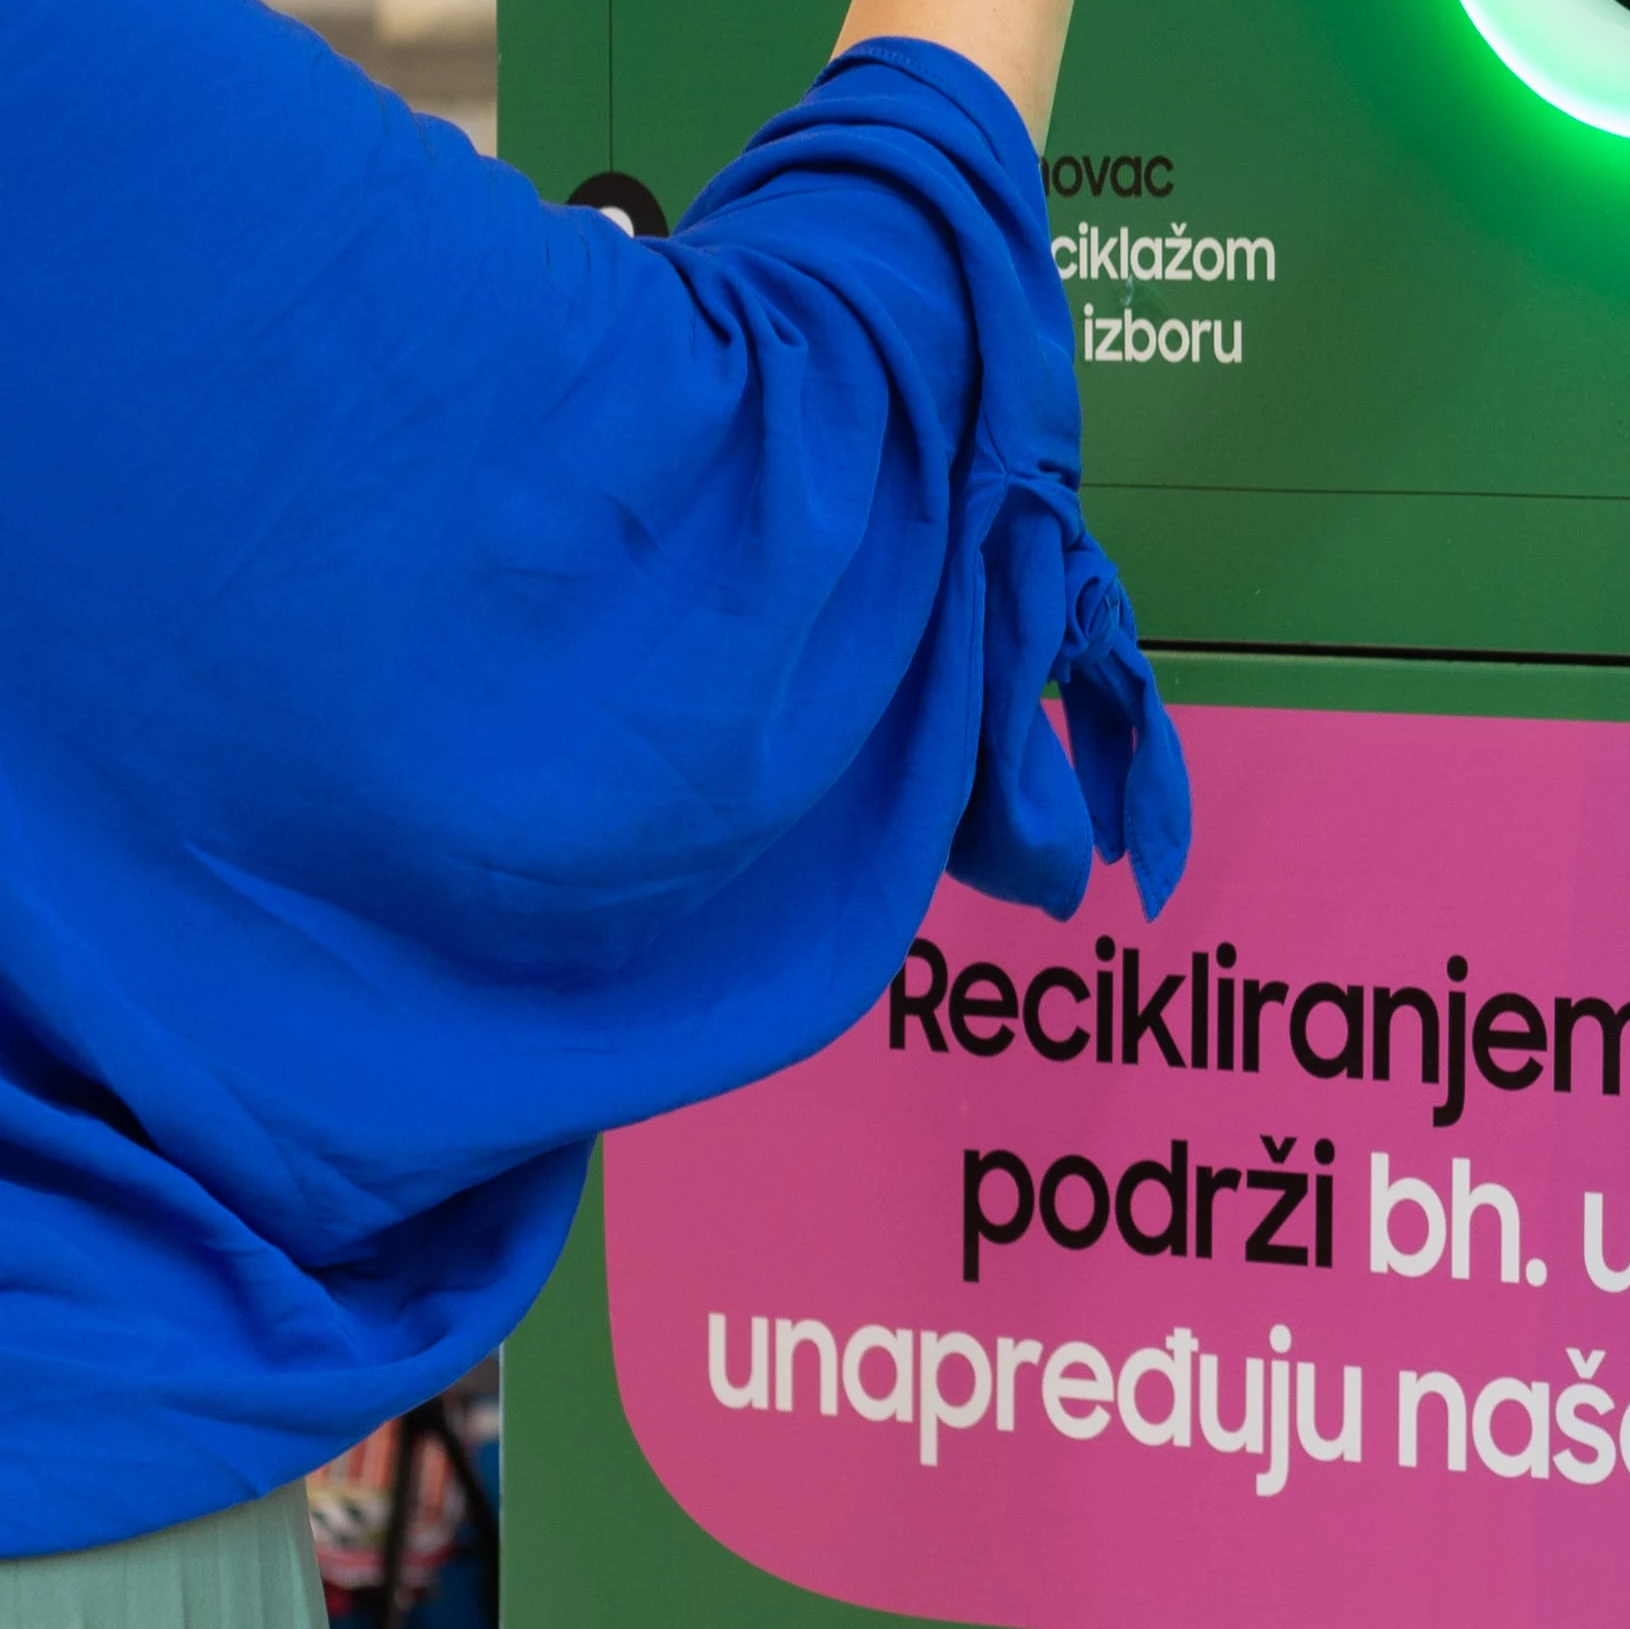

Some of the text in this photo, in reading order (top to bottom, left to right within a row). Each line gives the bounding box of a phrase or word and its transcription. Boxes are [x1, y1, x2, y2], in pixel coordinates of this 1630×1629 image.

[1084, 302, 1242, 363] izboru
[962, 1136, 1336, 1283] podrži
[1369, 1152, 1547, 1287] bh.
[708, 1312, 1362, 1497] unapređuju
